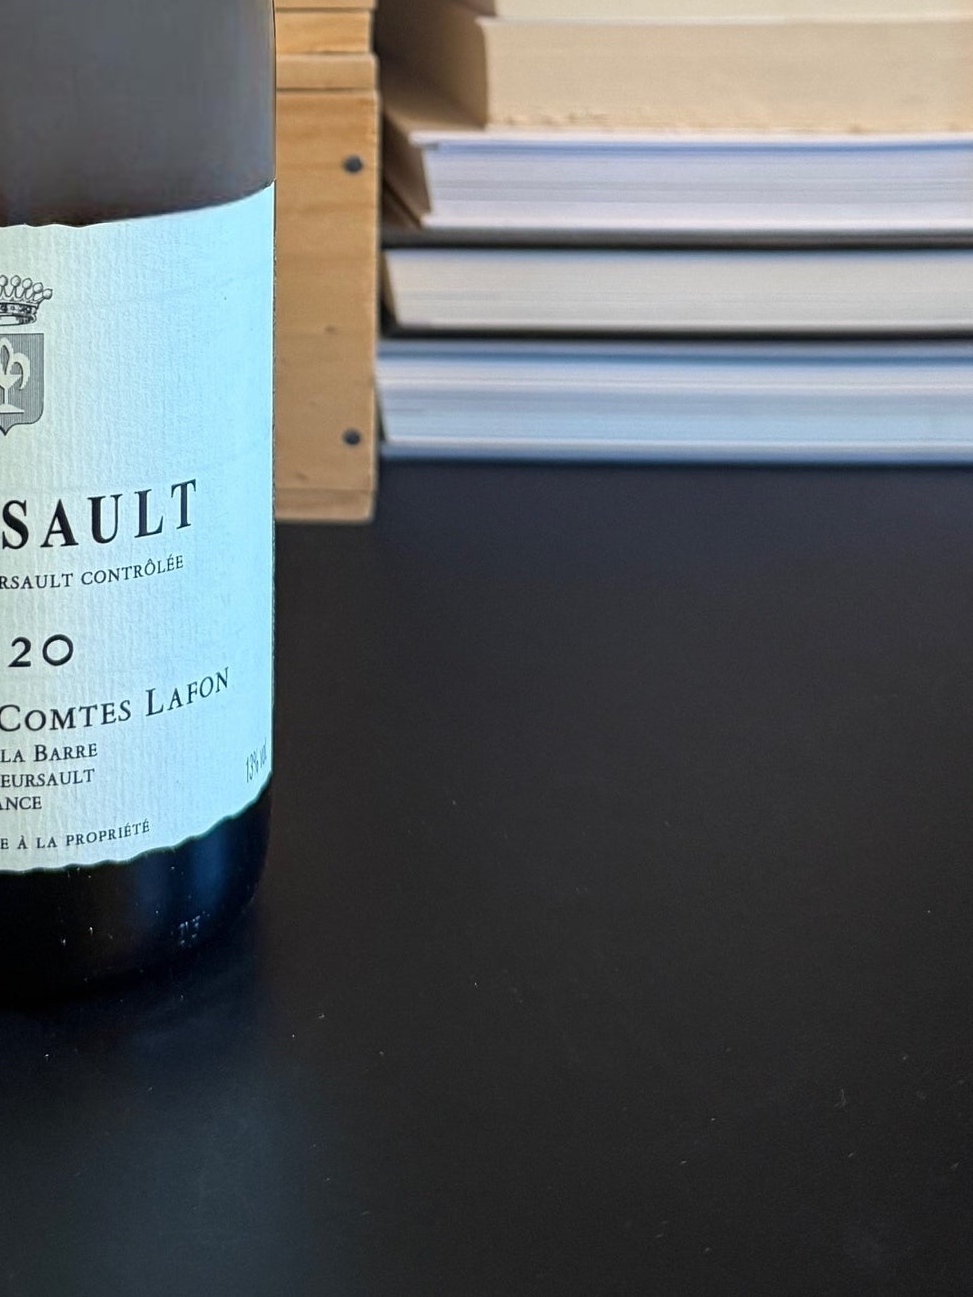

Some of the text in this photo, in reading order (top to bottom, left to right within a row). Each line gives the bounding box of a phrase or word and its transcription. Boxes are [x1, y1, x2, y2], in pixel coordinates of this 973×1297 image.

[80, 553, 184, 586] CONTRÔLÉE
[144, 666, 229, 717] LAFON
[0, 748, 27, 764] LA
[33, 742, 99, 763] BARRE
[35, 836, 58, 850] LA
[65, 817, 150, 847] PROPRIÉTÉ
